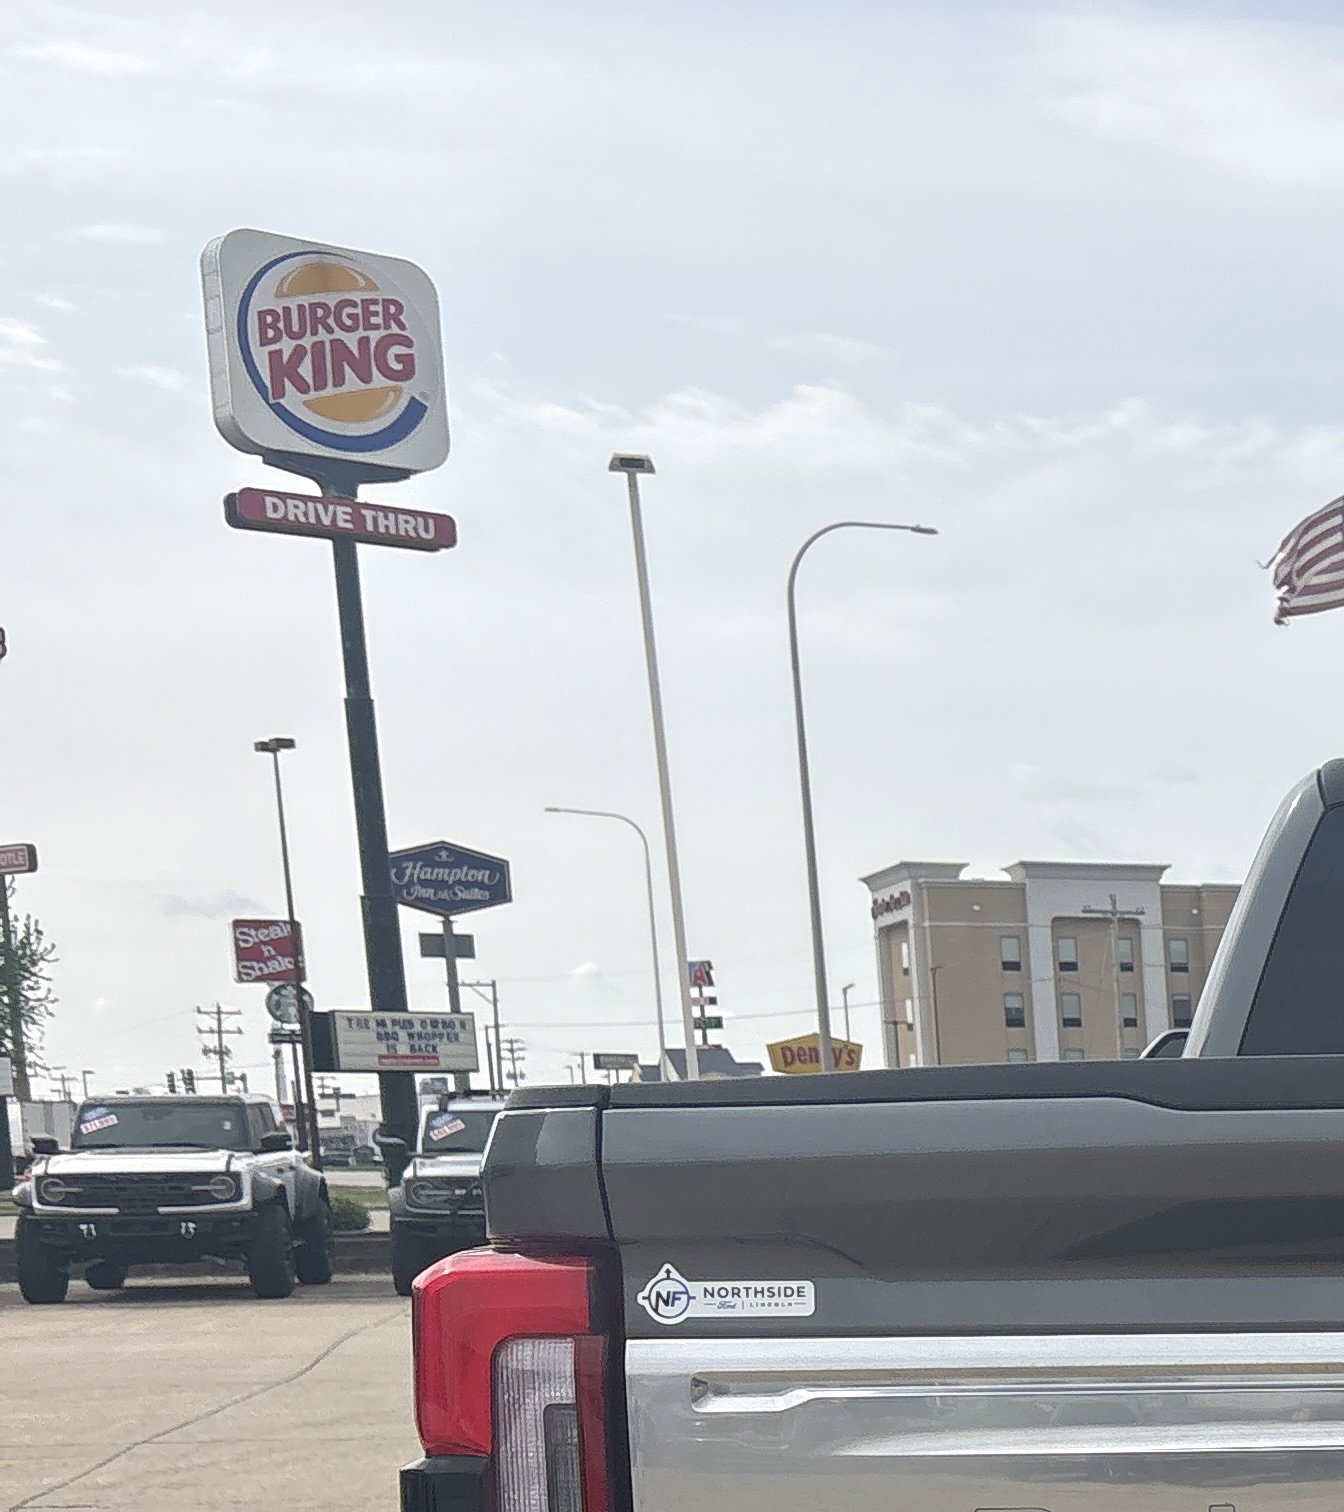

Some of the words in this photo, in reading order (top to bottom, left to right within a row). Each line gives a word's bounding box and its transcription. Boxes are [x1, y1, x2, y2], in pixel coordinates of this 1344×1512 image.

[257, 298, 407, 347] BURGER
[268, 333, 416, 400] KING
[263, 496, 354, 530] DRIVE
[361, 509, 435, 540] THRU
[391, 861, 500, 885] Hampton
[347, 1017, 370, 1030] THE
[409, 1044, 438, 1054] BACK
[780, 1045, 856, 1068] Deny's
[655, 1290, 687, 1310] NF
[703, 1286, 807, 1299] NORTHSIDE
[717, 1300, 737, 1310] Ford
